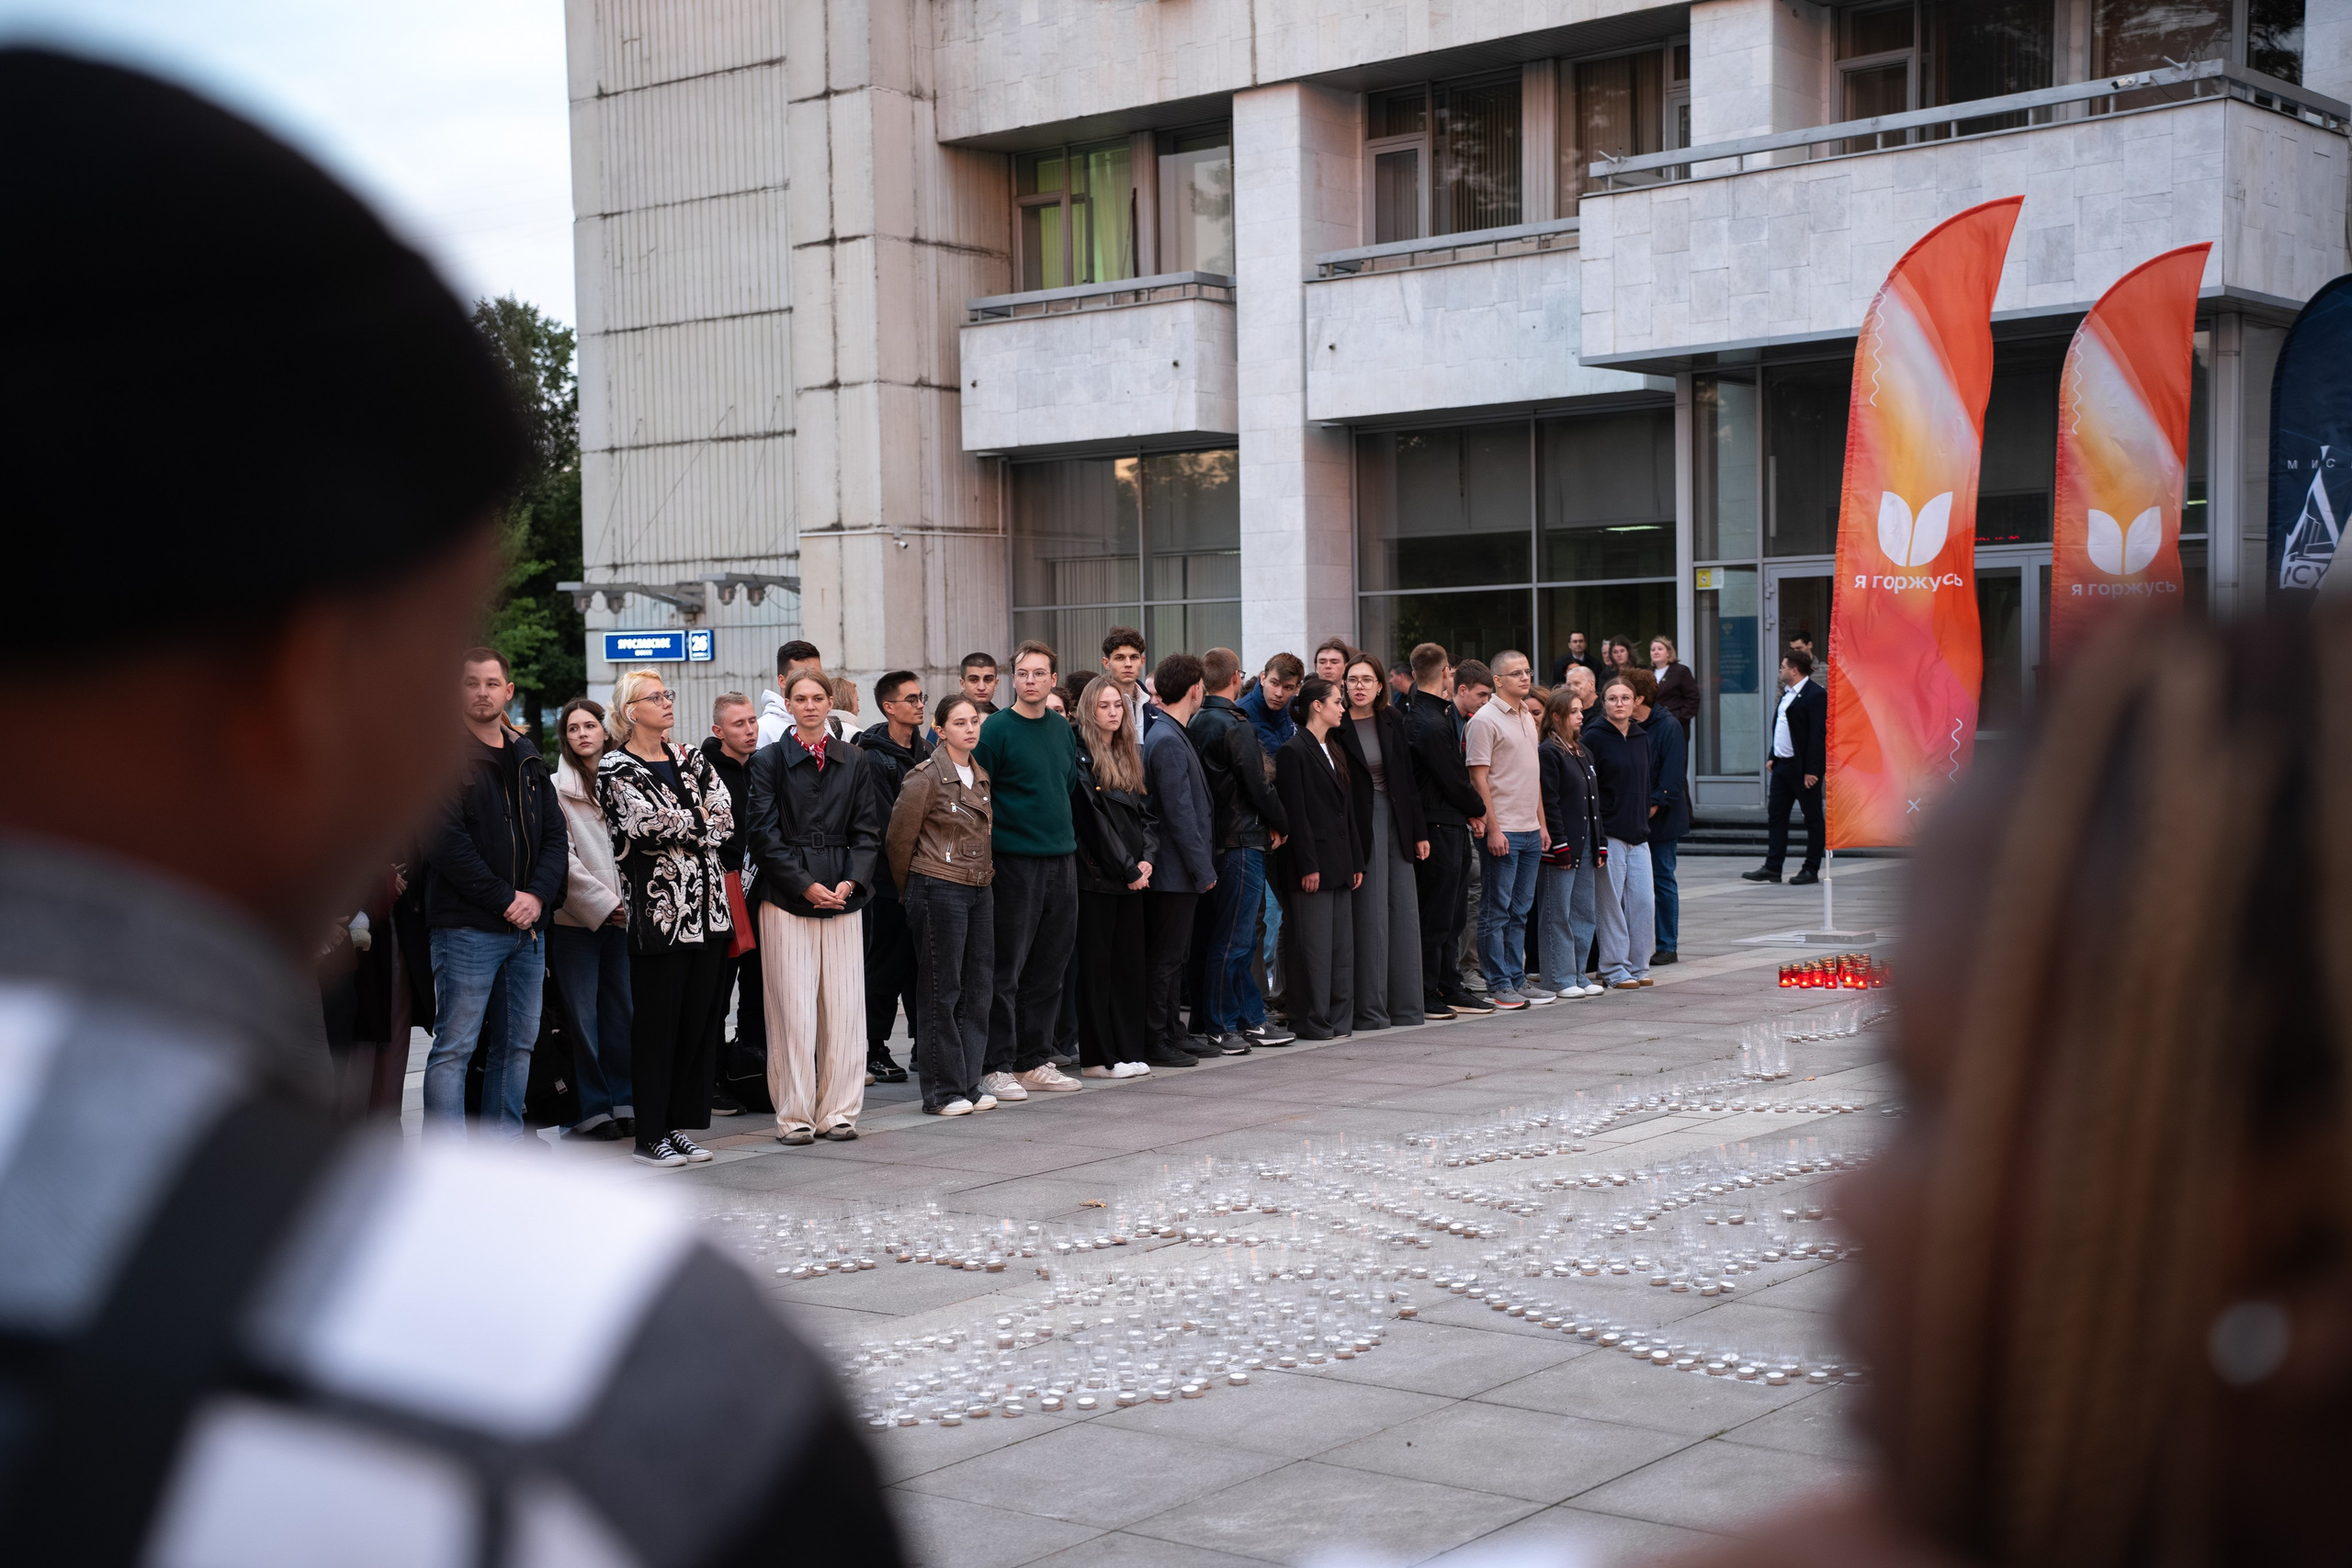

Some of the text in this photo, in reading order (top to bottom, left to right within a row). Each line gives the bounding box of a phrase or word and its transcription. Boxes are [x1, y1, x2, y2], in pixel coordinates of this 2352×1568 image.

[2287, 457, 2352, 470] МИС
[1854, 573, 1963, 594] я горжусь
[2071, 581, 2177, 599] я горжусь
